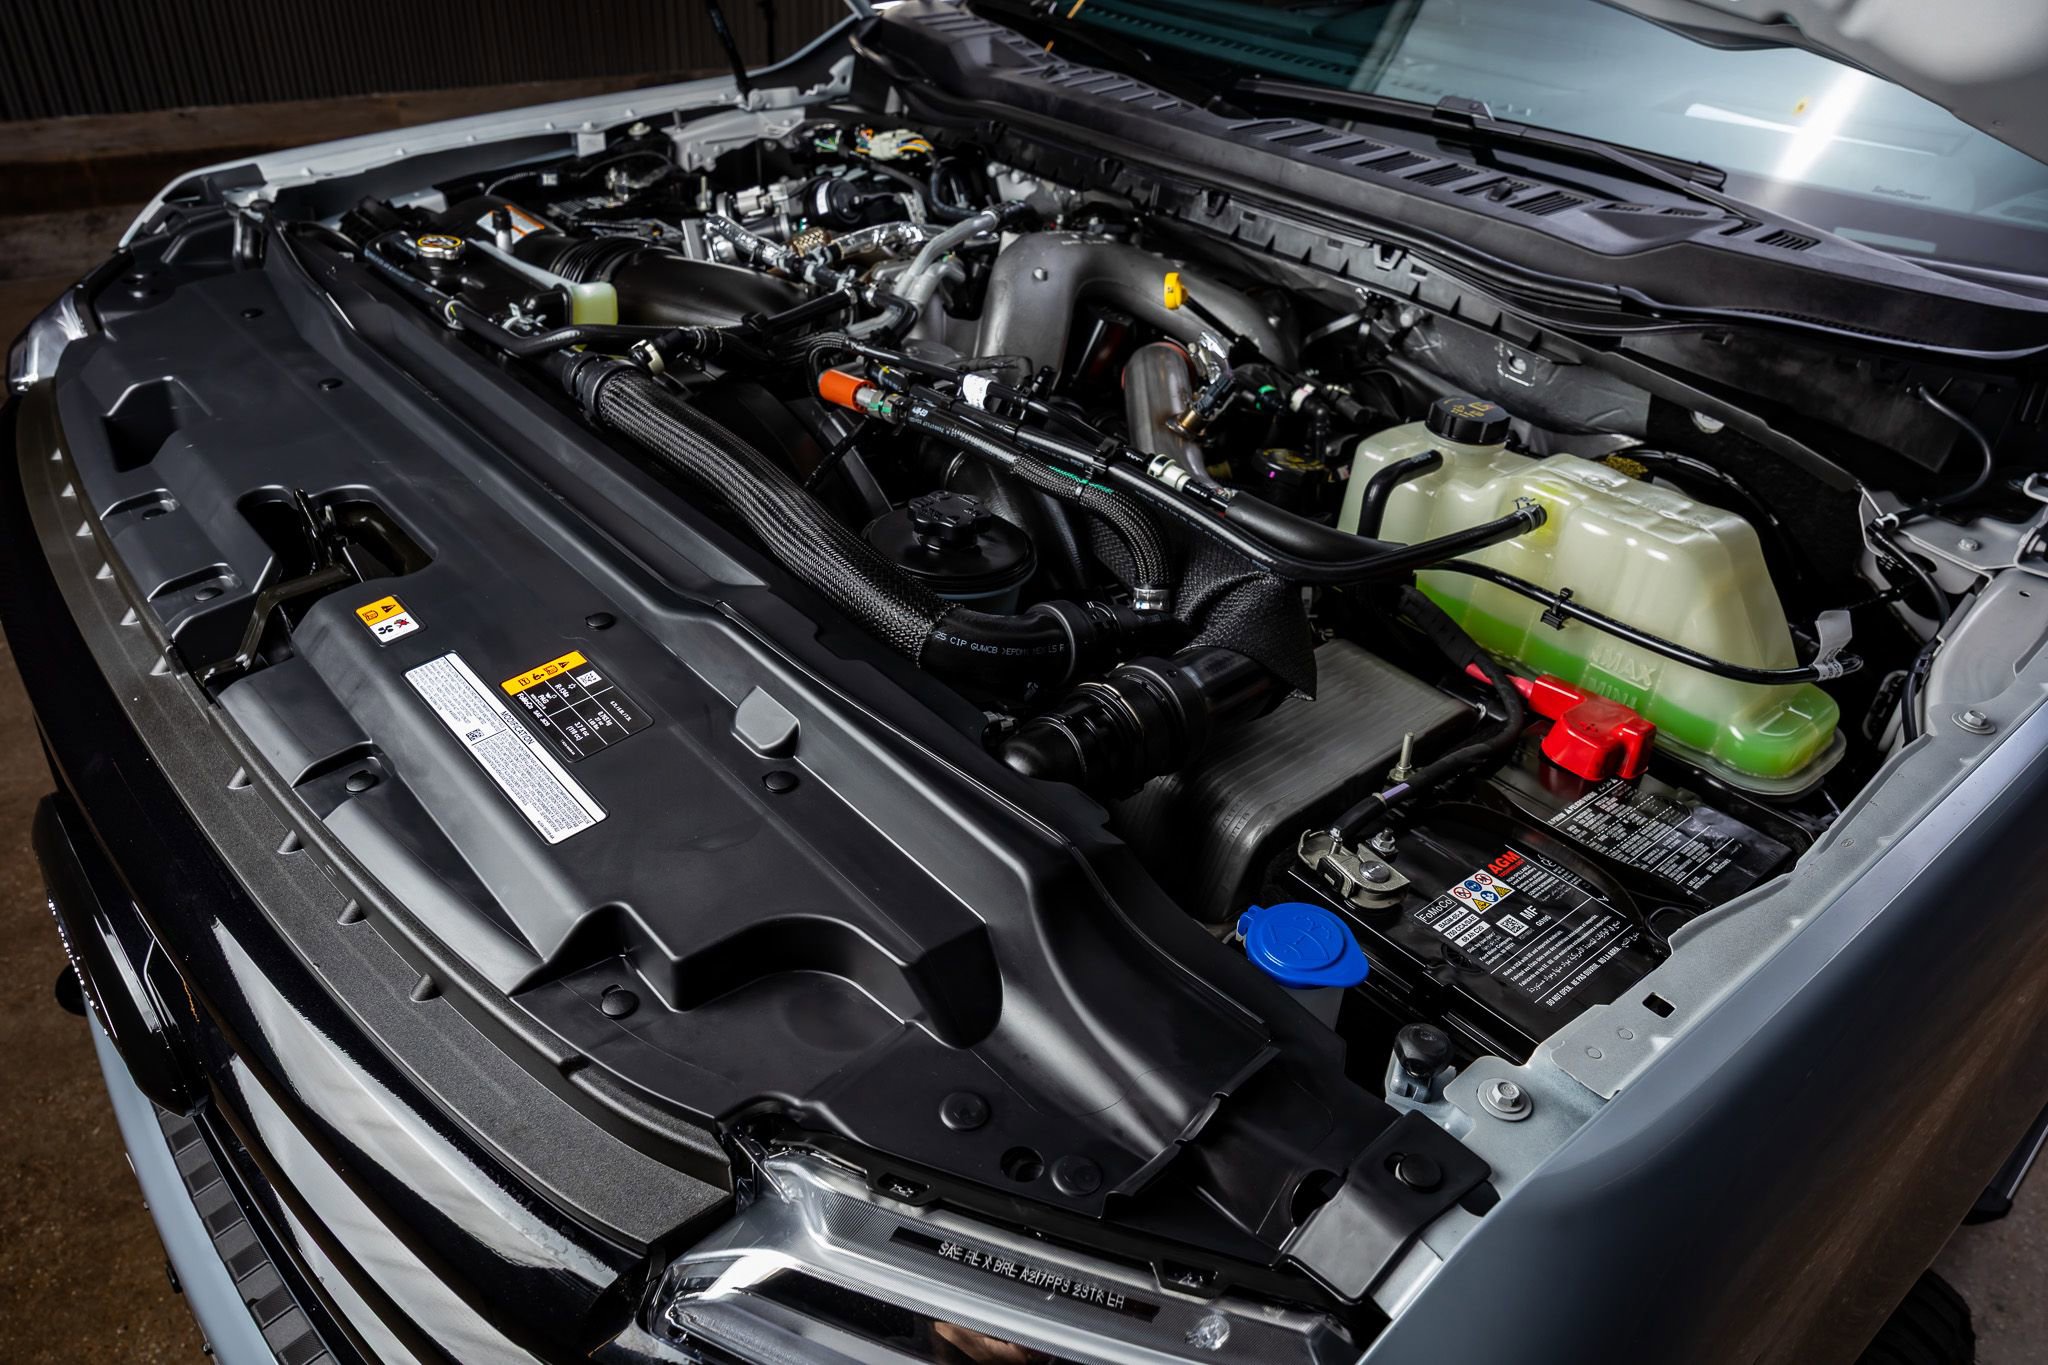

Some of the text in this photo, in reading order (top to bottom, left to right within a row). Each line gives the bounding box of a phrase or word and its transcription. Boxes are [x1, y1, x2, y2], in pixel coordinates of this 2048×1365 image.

[515, 692, 535, 709] FoMoCo
[499, 710, 535, 745] MODIFICATION
[1488, 851, 1520, 874] AGM
[1419, 899, 1452, 921] FoMoCo
[1520, 905, 1538, 920] MF
[938, 1241, 963, 1261] SAE
